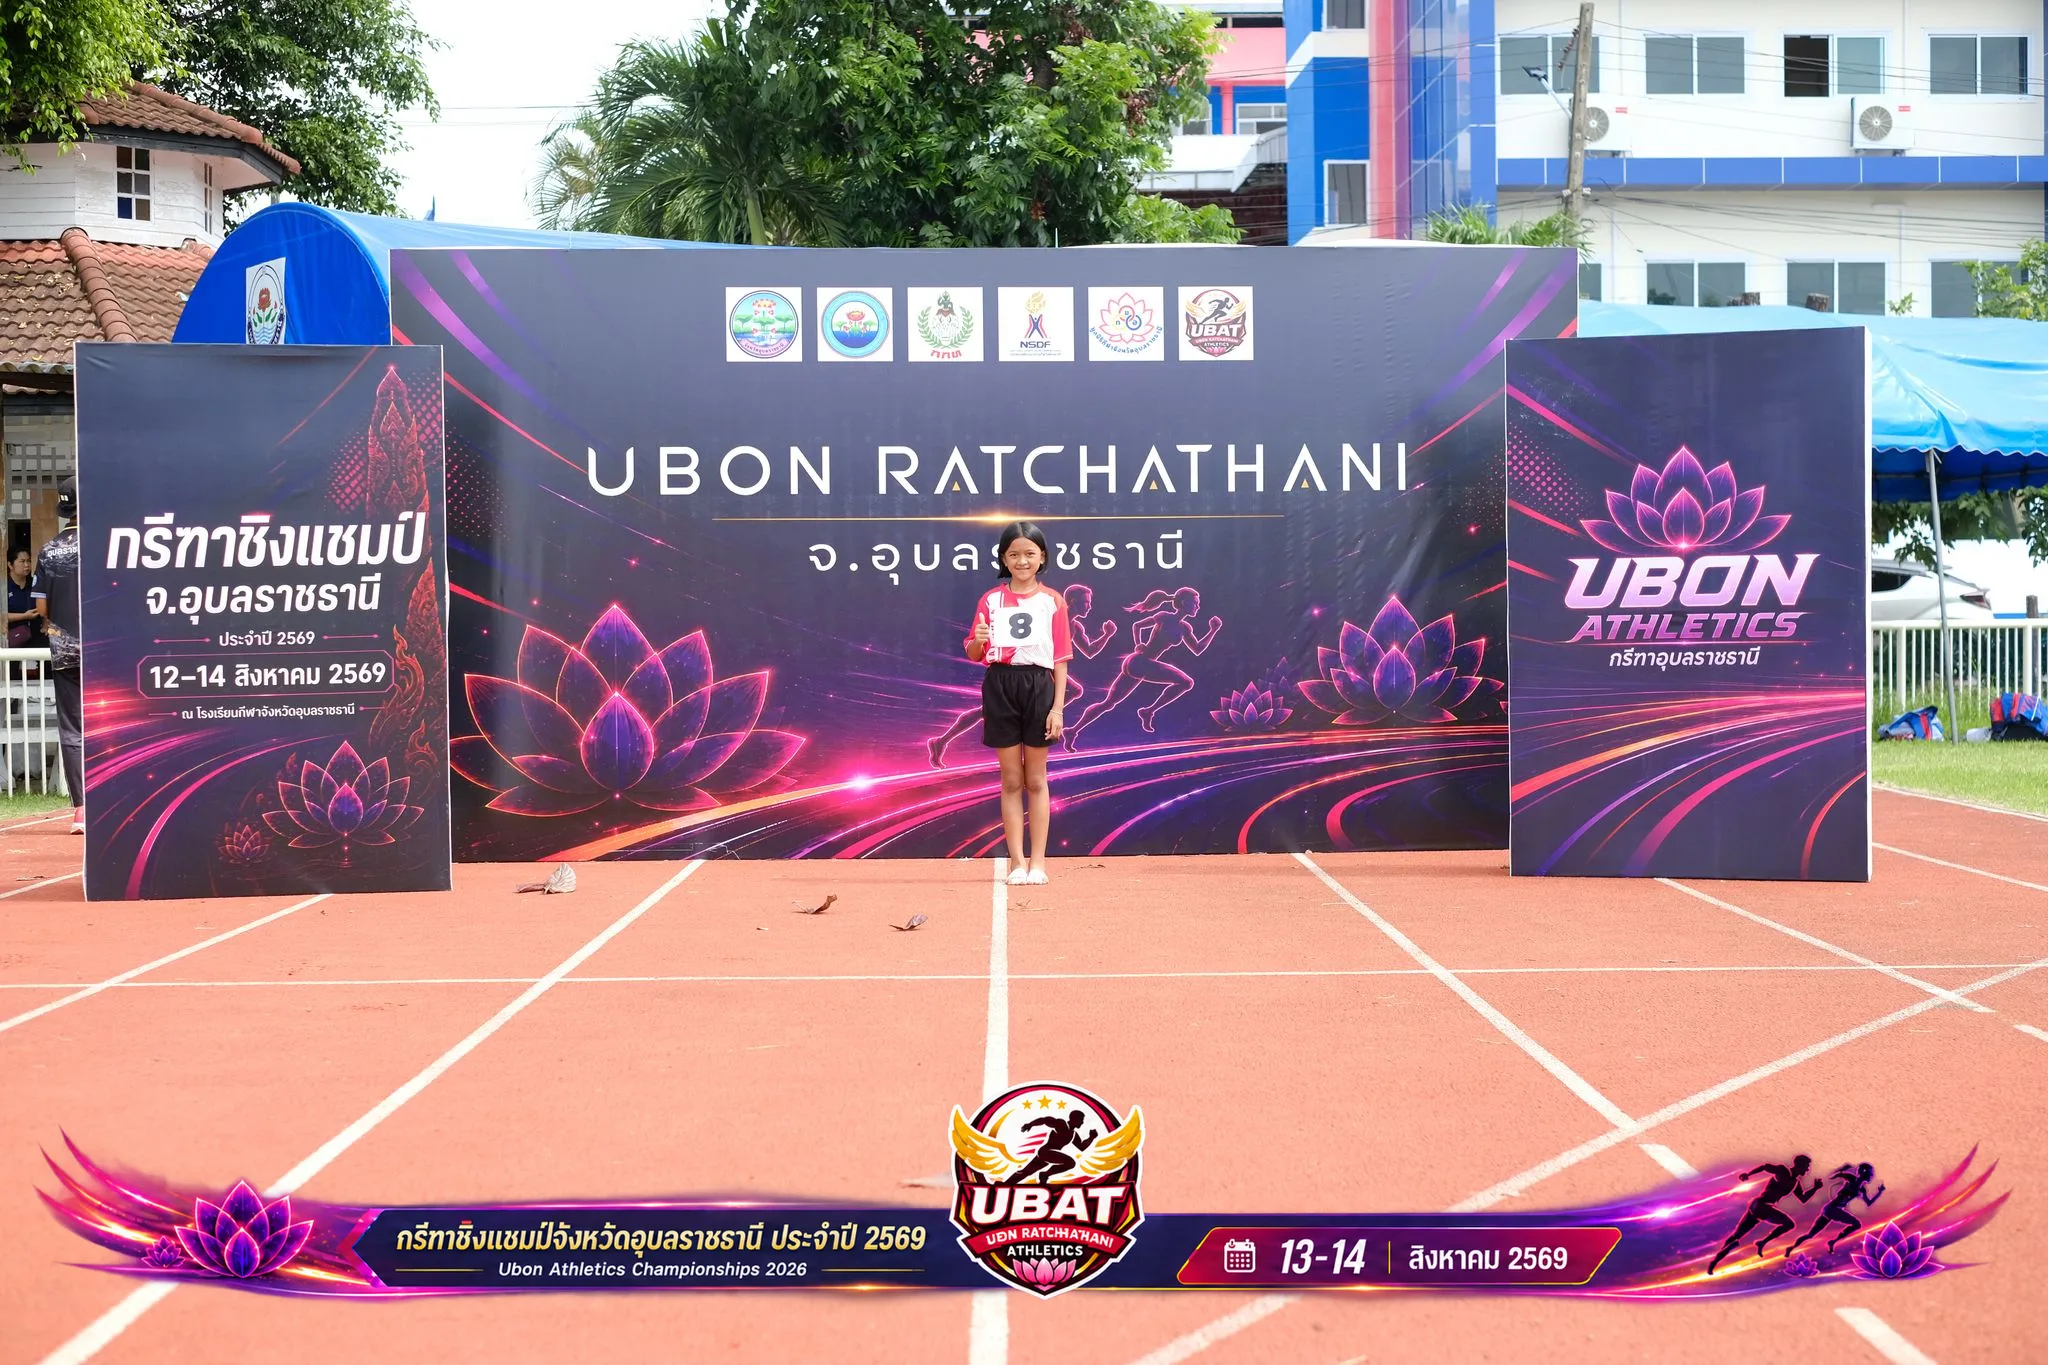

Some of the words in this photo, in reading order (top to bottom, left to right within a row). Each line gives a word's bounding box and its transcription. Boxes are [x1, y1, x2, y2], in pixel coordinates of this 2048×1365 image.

[1190, 324, 1242, 338] UBAT
[587, 446, 831, 497] UBON
[877, 442, 1407, 496] RATCHATHANI
[106, 511, 427, 570] กรีฑาชิงแชมป์
[808, 529, 1184, 586] จ.อุบลชธานี
[1564, 553, 1821, 609] UBON
[146, 573, 382, 625] จ.อุบลราชธานี
[219, 630, 273, 648] ประจำปี
[276, 631, 316, 646] 2569
[1008, 612, 1034, 639] 8
[1564, 612, 1815, 643] ATHLETICS
[1608, 646, 1762, 671] กรีฑาอุบลราชธานี
[234, 662, 321, 687] สิงหาคม
[328, 662, 387, 685] 2569
[181, 709, 194, 720] ณ
[196, 702, 356, 721] โรงเรียนกีฬาจังหวัดอุบลราชธานี
